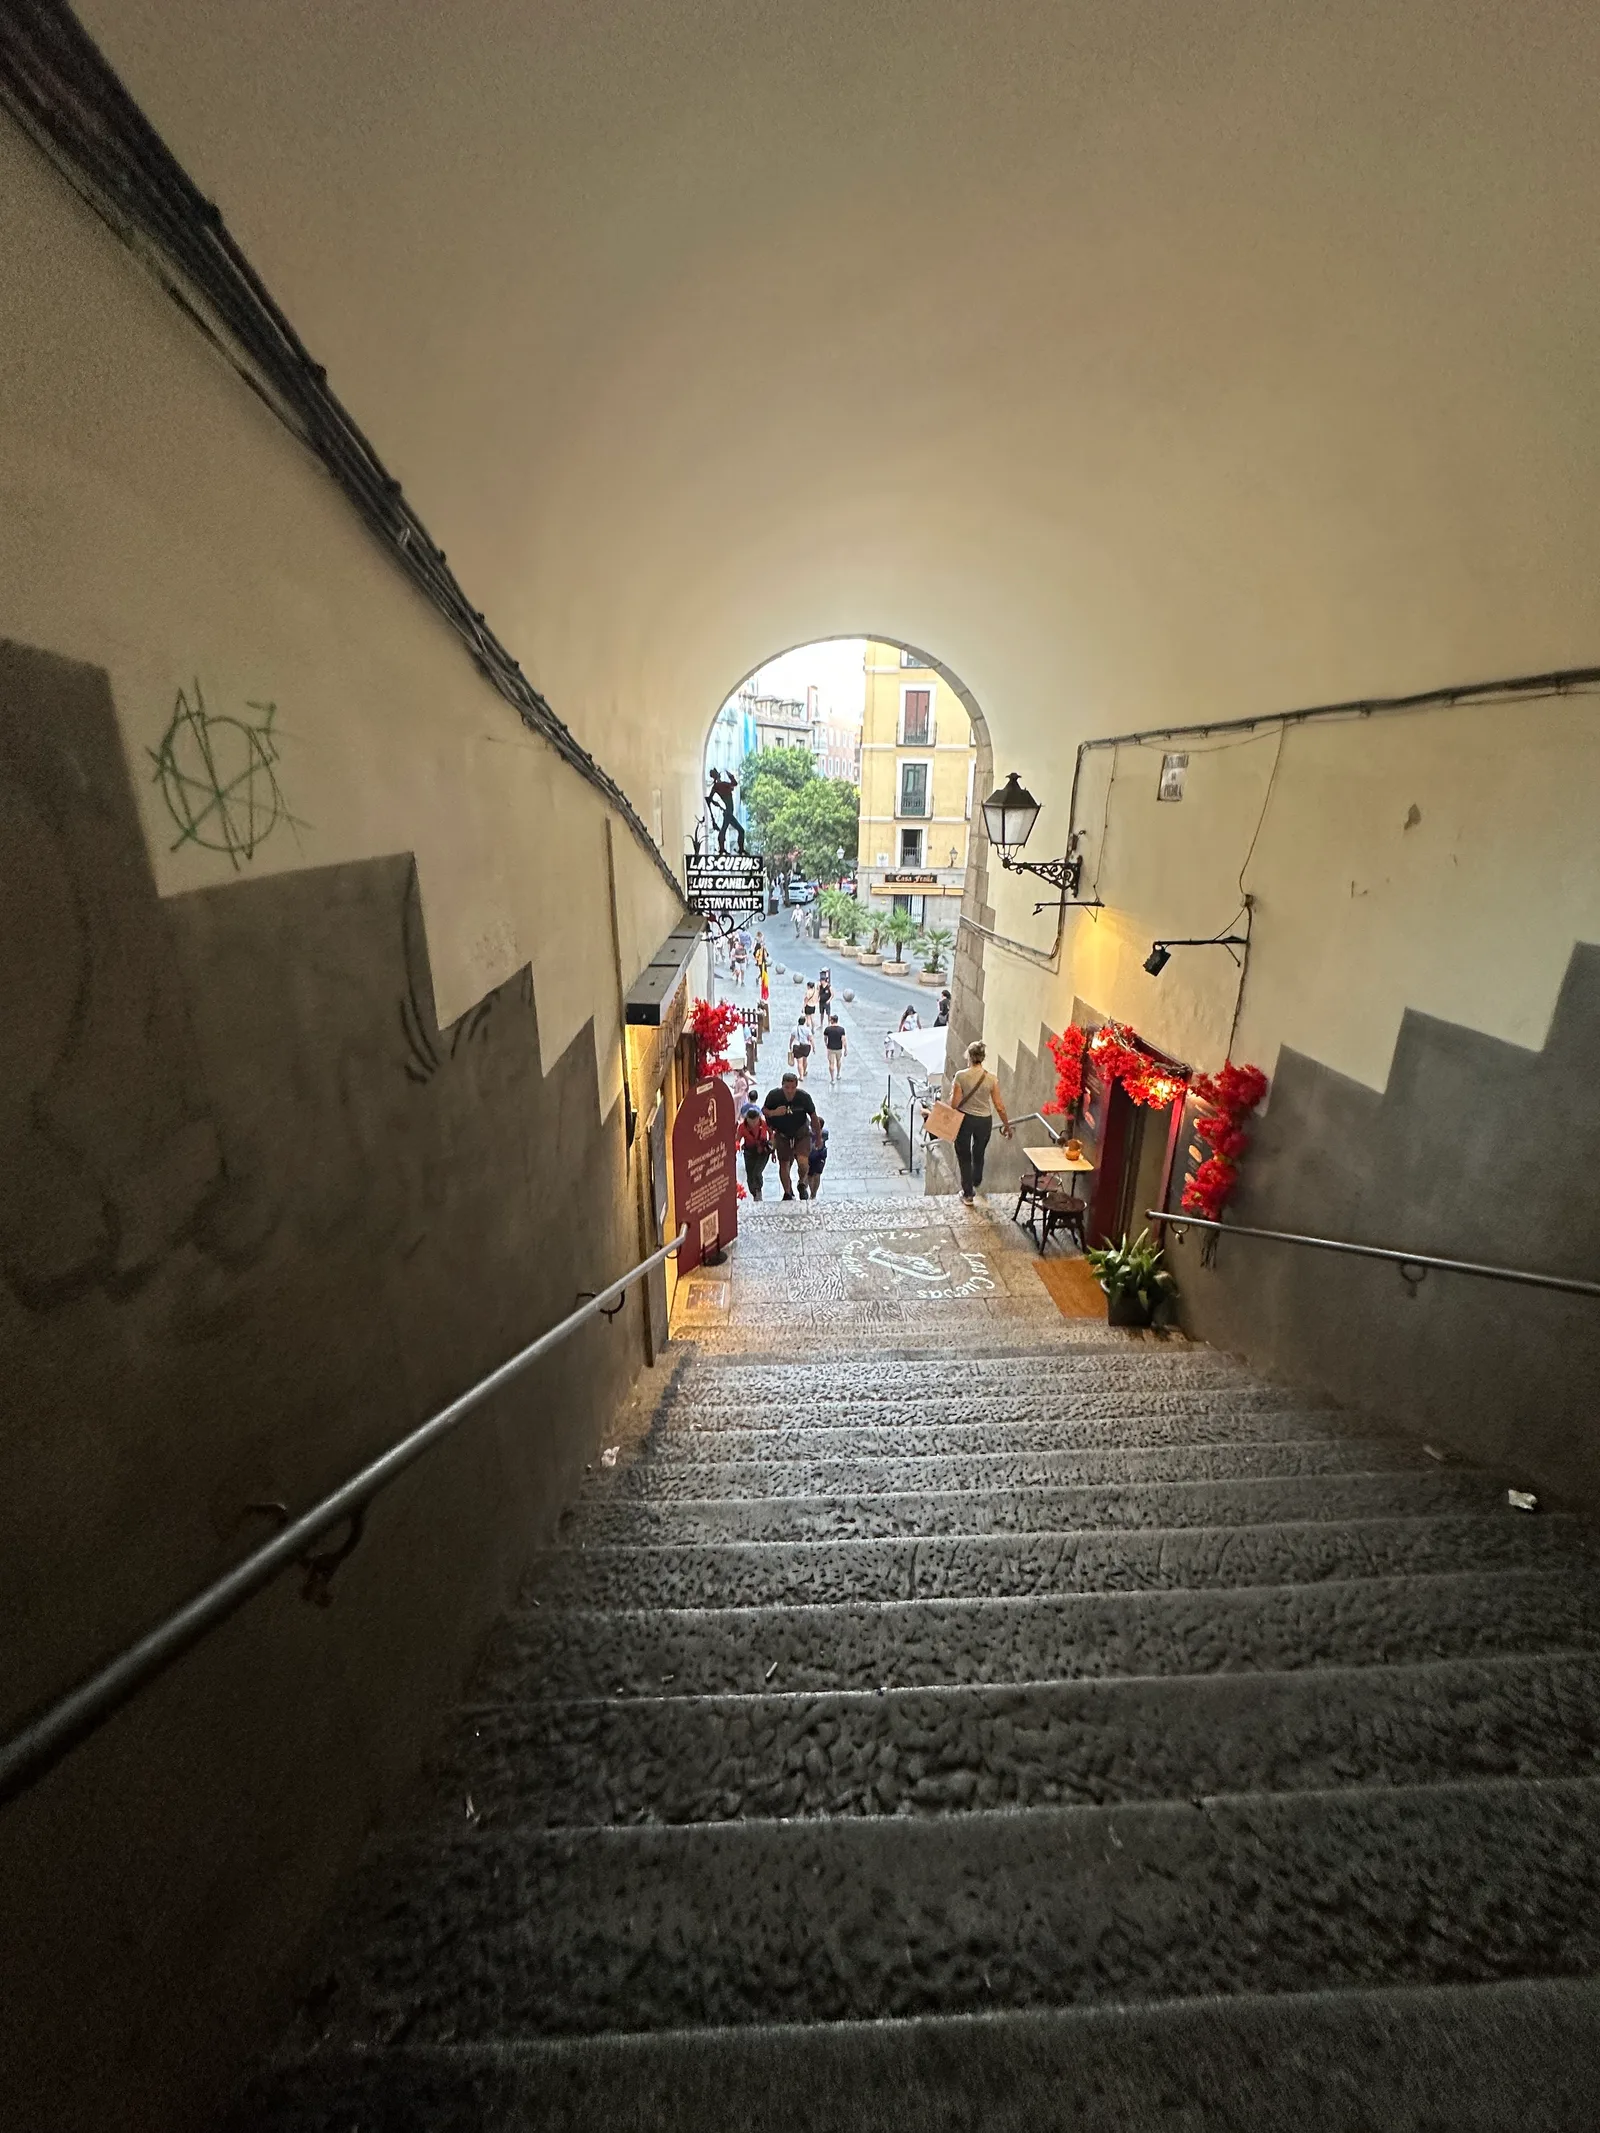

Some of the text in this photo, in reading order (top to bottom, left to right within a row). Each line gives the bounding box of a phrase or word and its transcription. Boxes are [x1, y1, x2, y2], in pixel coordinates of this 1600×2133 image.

[692, 877, 714, 889] LUIS
[895, 874, 912, 883] Casa
[916, 1276, 995, 1299] Cuevas
